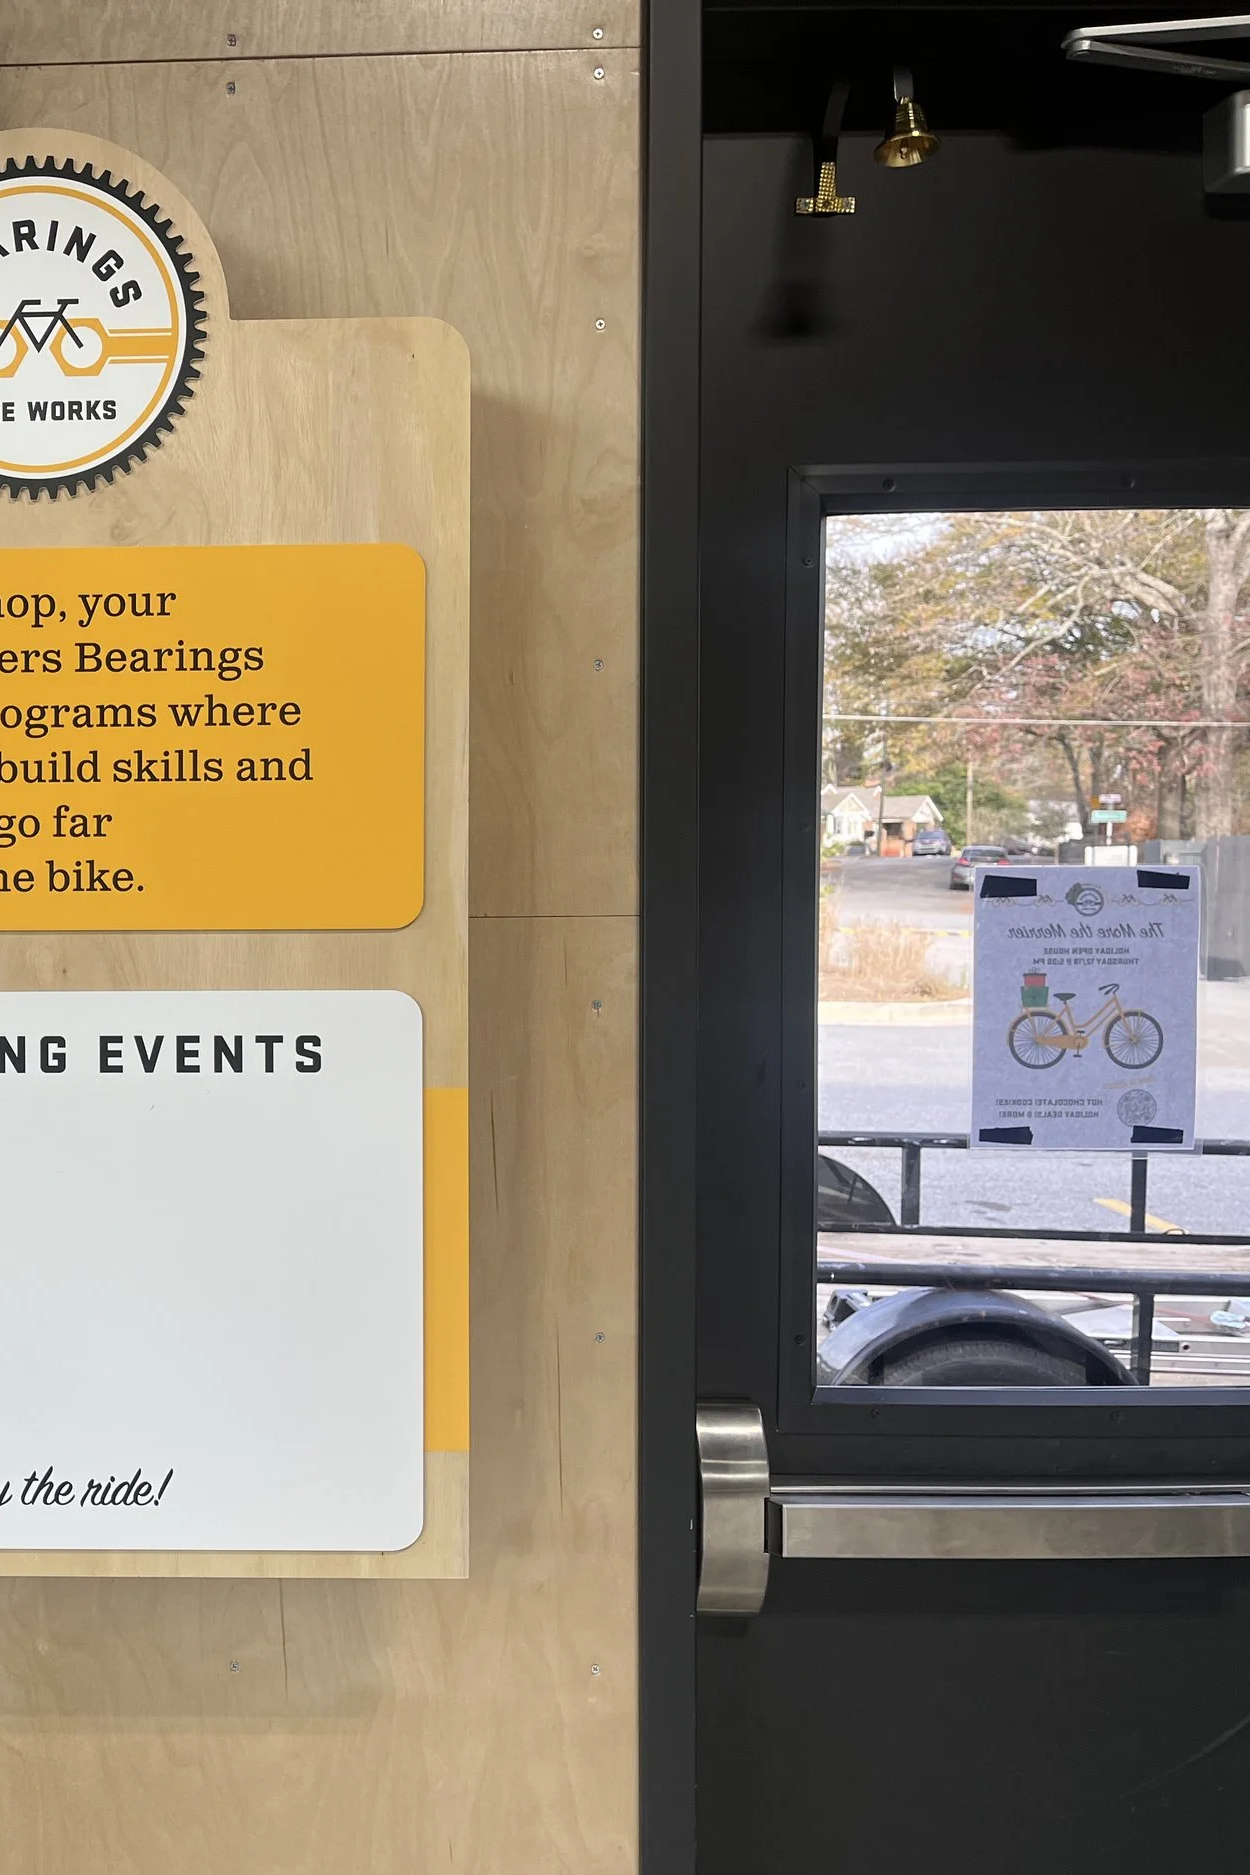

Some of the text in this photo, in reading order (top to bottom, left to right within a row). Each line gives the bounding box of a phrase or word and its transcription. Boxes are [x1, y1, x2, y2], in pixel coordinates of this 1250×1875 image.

[27, 399, 117, 422] WORKS
[77, 592, 177, 628] your
[74, 639, 264, 682] Bearings
[167, 693, 301, 727] where
[113, 749, 224, 783] skills
[236, 747, 314, 782] and
[52, 804, 113, 838] far
[45, 859, 144, 893] bike.
[99, 1034, 322, 1074] EVENTS
[20, 1465, 76, 1506] the
[80, 1467, 174, 1507] ride!
